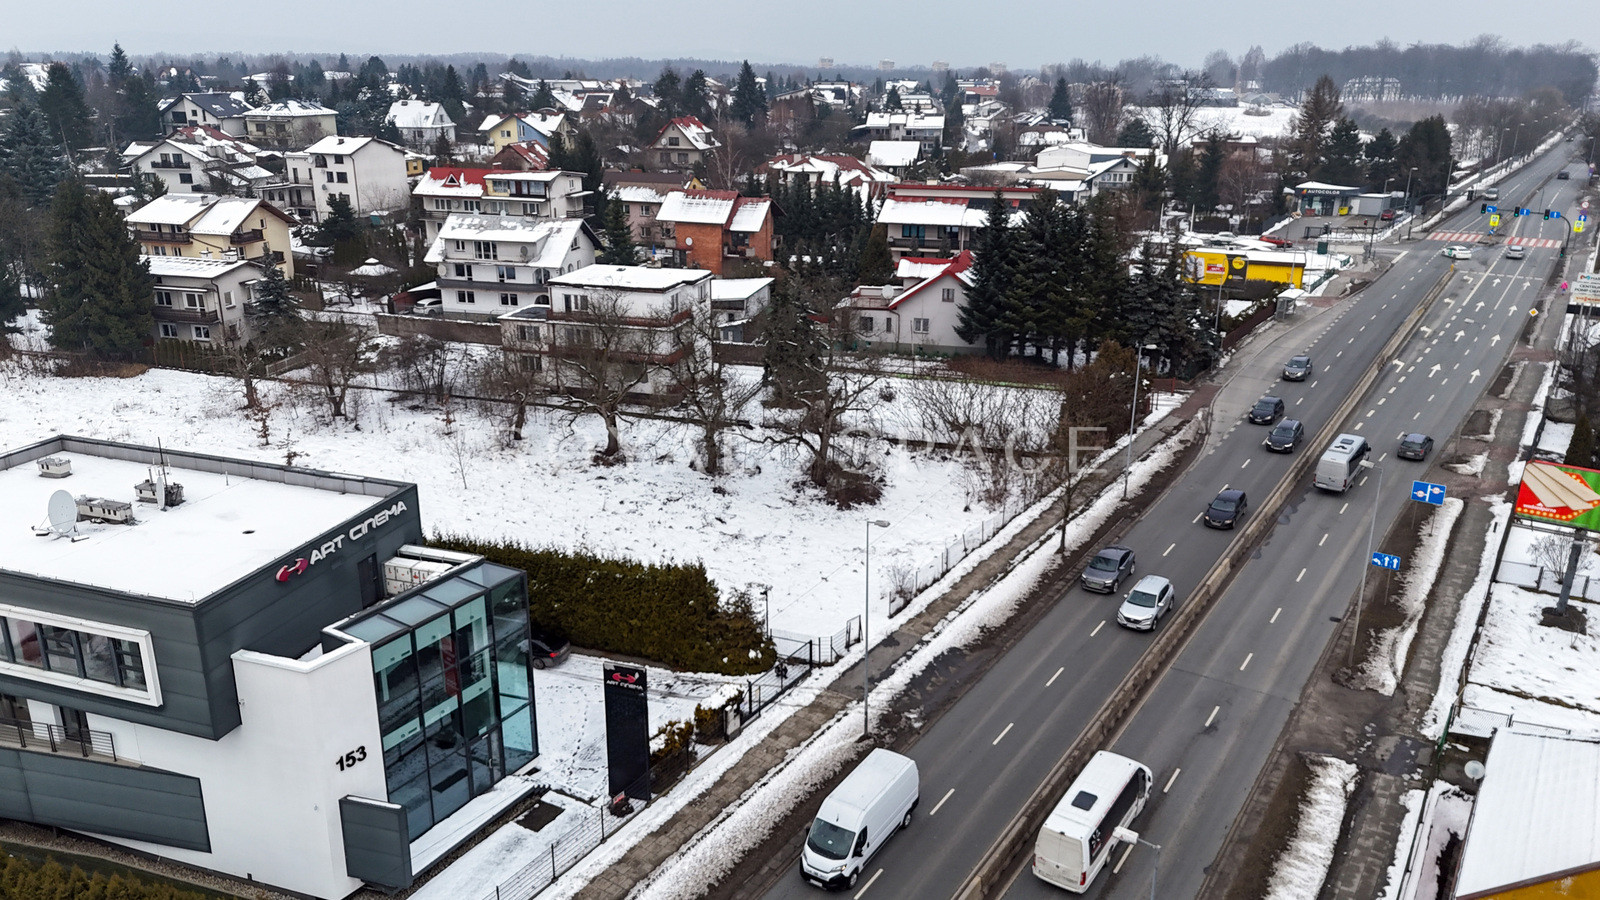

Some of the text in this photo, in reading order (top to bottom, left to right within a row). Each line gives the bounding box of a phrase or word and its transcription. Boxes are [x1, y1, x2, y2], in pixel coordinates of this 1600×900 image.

[309, 501, 407, 565] ART CINEMA
[335, 745, 367, 772] 153
